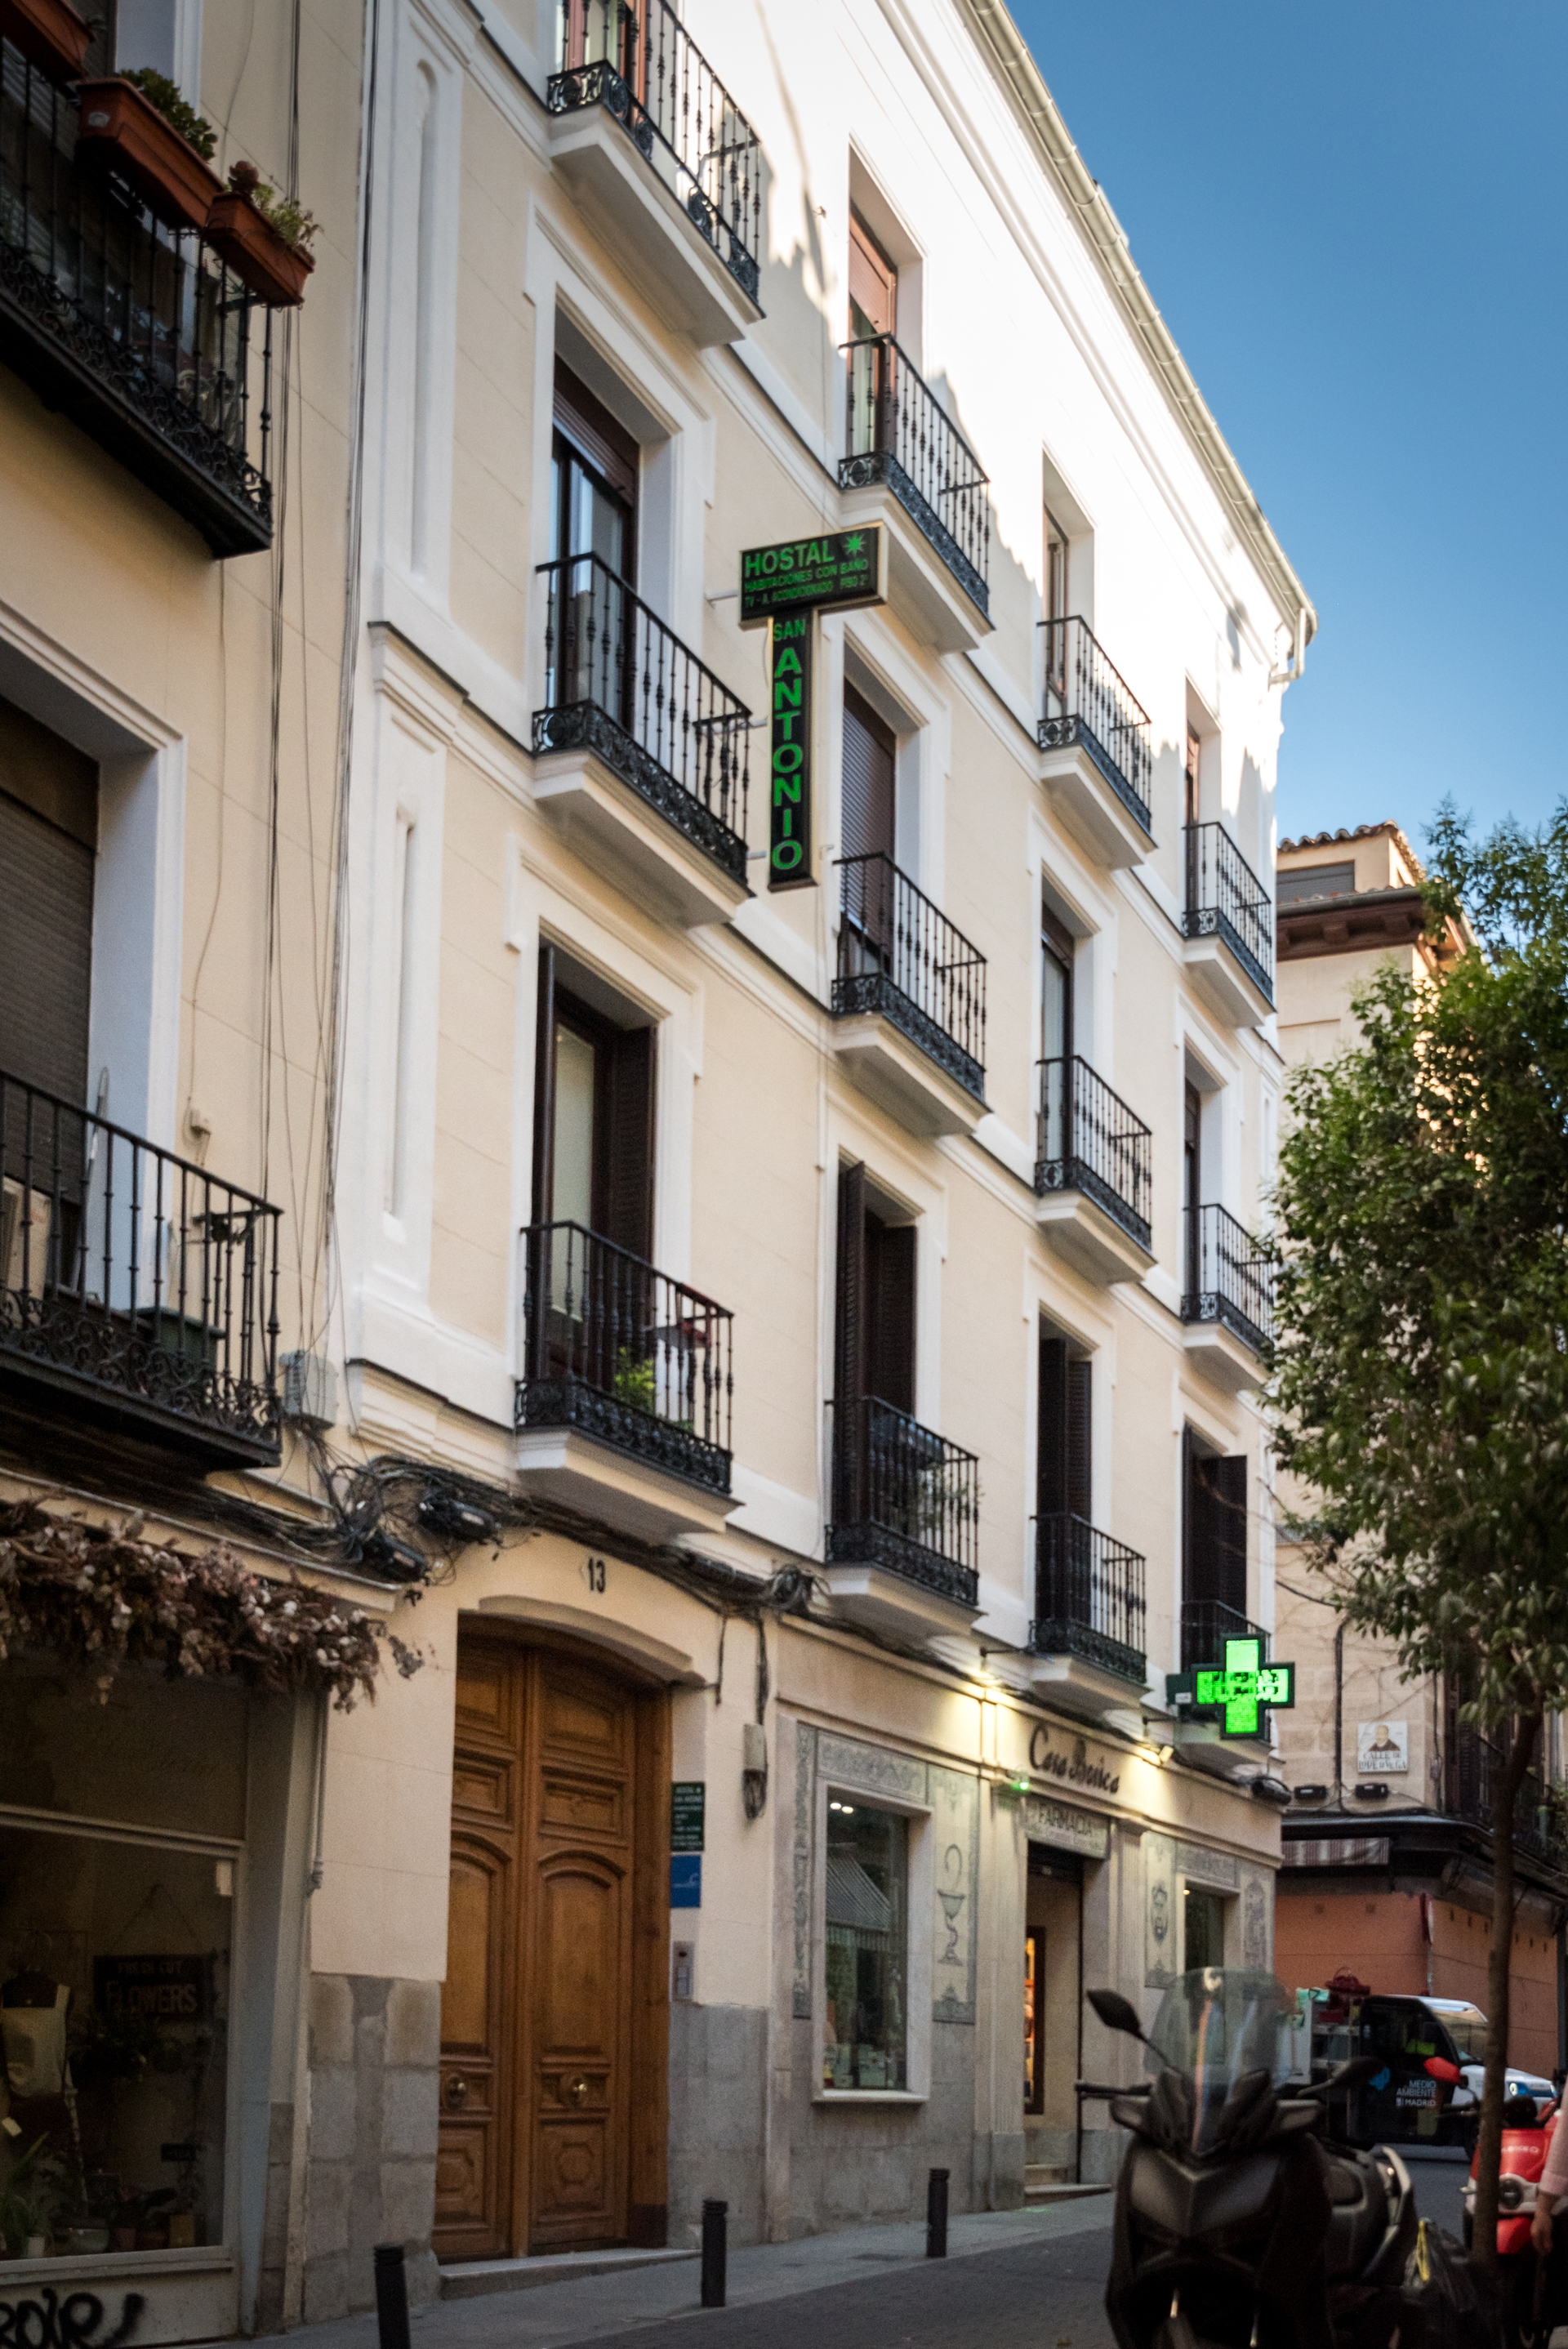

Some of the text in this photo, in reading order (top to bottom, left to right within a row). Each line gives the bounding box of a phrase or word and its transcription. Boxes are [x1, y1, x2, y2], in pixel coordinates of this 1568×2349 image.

[745, 540, 834, 578] HOSTAL
[816, 564, 837, 578] CON
[773, 618, 806, 641] SAN
[772, 646, 803, 870] ANTONIO
[588, 1556, 606, 1593] 13
[1363, 1751, 1390, 1759] CALLE
[159, 1960, 182, 1974] CUT
[105, 1980, 198, 2014] FLOWERS
[1409, 2079, 1437, 2088] MEDIO
[1396, 2088, 1437, 2097] AMBIENTE
[1405, 2098, 1437, 2106] MADRID
